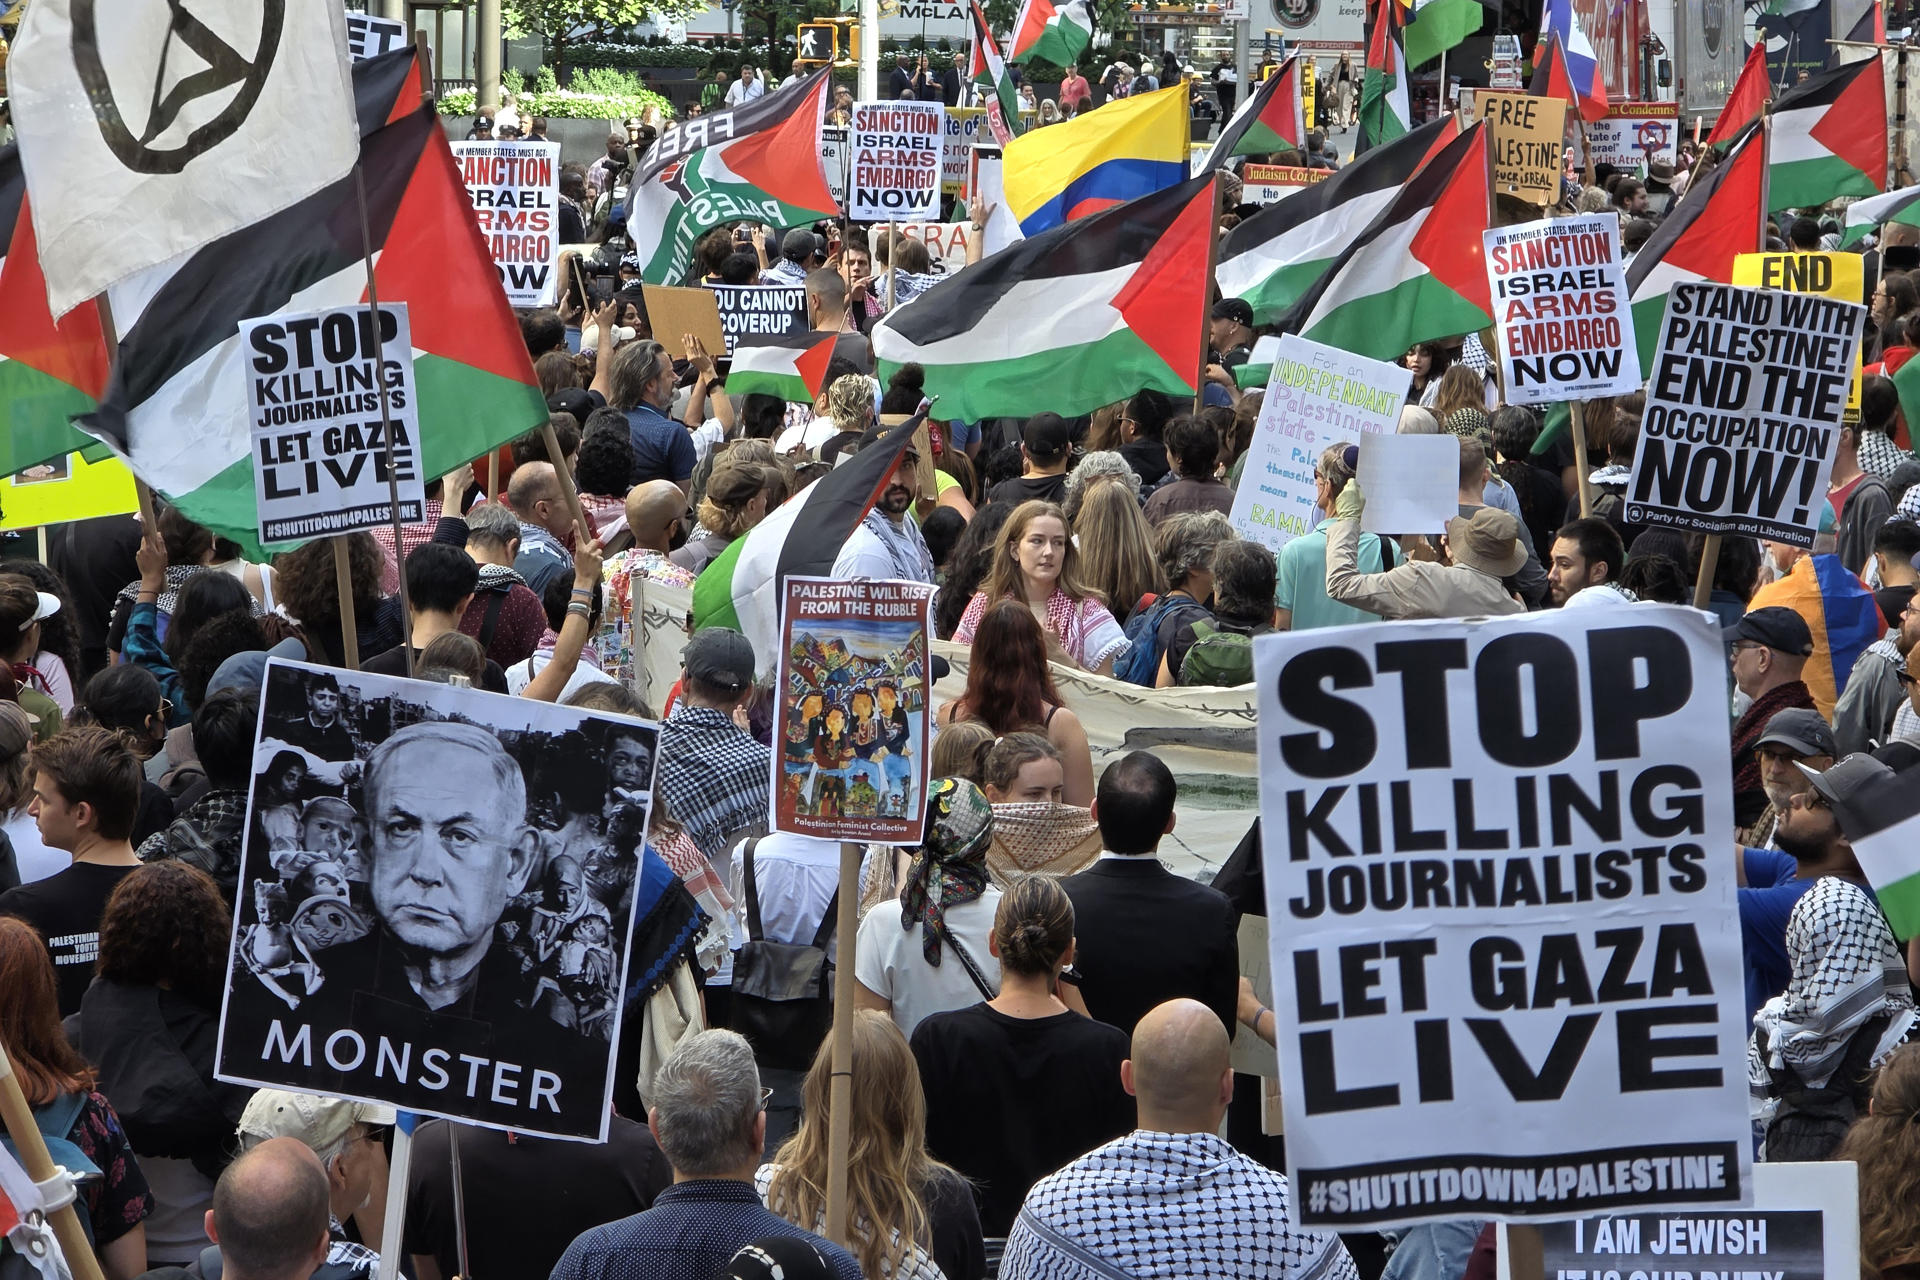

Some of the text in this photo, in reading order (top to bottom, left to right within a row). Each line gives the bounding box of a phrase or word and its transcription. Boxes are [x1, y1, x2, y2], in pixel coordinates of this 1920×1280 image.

[1338, 6, 1364, 18] keep
[856, 111, 939, 135] SANCTION
[1484, 98, 1538, 130] FREE
[1620, 104, 1675, 115] Condemns
[1587, 132, 1622, 142] tate of
[1594, 122, 1610, 131] the
[465, 148, 492, 156] MEMBER
[493, 148, 516, 157] STATES
[518, 149, 534, 157] MUST
[856, 135, 937, 150] ISRAEL
[1591, 144, 1619, 153] srael"
[857, 149, 937, 167] ARMS
[856, 167, 936, 189] EMBARGO
[1248, 166, 1288, 181] Judaism
[467, 189, 551, 209] RAEL
[856, 188, 934, 208] NOW
[1263, 188, 1279, 199] the
[475, 210, 550, 232] RMS
[1496, 222, 1605, 246] UN MEMBER STATES MUST ACT:
[483, 233, 550, 263] ARGO
[1492, 232, 1612, 275] SANCTION
[1497, 269, 1615, 299] ISRAEL
[1761, 255, 1832, 292] END
[714, 290, 804, 311] OU CANNOT
[1505, 291, 1617, 323] ARMS
[1671, 285, 1860, 337] STAND WITH
[250, 310, 398, 374] STOP
[1506, 316, 1621, 357] EMBARGO
[1665, 317, 1852, 374] PALESTINE!
[1312, 352, 1364, 378] For an
[1512, 349, 1623, 387] NOW
[256, 360, 405, 406] KILLING
[1272, 357, 1401, 417] INDEPENDANT
[1654, 352, 1753, 411] END
[1761, 365, 1846, 423] THE
[257, 391, 406, 427] JOURNALISS
[260, 419, 410, 466] LET GAZA
[1645, 405, 1832, 460] OCCUPATION
[262, 448, 416, 501] LIVE
[1266, 461, 1316, 485] themselve
[1633, 437, 1821, 526] NOW!
[1259, 484, 1288, 498] means
[1646, 511, 1673, 525] Party
[1675, 515, 1690, 526] for
[1691, 519, 1736, 532] Socialism
[1737, 522, 1757, 533] and
[1759, 525, 1811, 544] Liberation
[791, 584, 929, 600] PALESTINE WILL RISE
[799, 601, 917, 617] FROM THE RUBBLE
[1277, 625, 1692, 779] STOP
[794, 817, 908, 832] Palestinian Feminist Collective
[1286, 764, 1705, 862] KILLING
[1288, 842, 1707, 919] JOURNALISTS
[49, 932, 99, 947] PALESTINIAN
[74, 942, 99, 953] YOUTH
[55, 952, 99, 965] MOVEMENT
[1293, 937, 1438, 1024] LET
[1468, 922, 1716, 1013] GAZA
[261, 1018, 563, 1114] MONSTER
[1298, 1004, 1724, 1117] LIVE
[1309, 1154, 1726, 1214] #SHUTITDOWN4PALESTINE
[1576, 1219, 1767, 1255] I AM JEWISH
